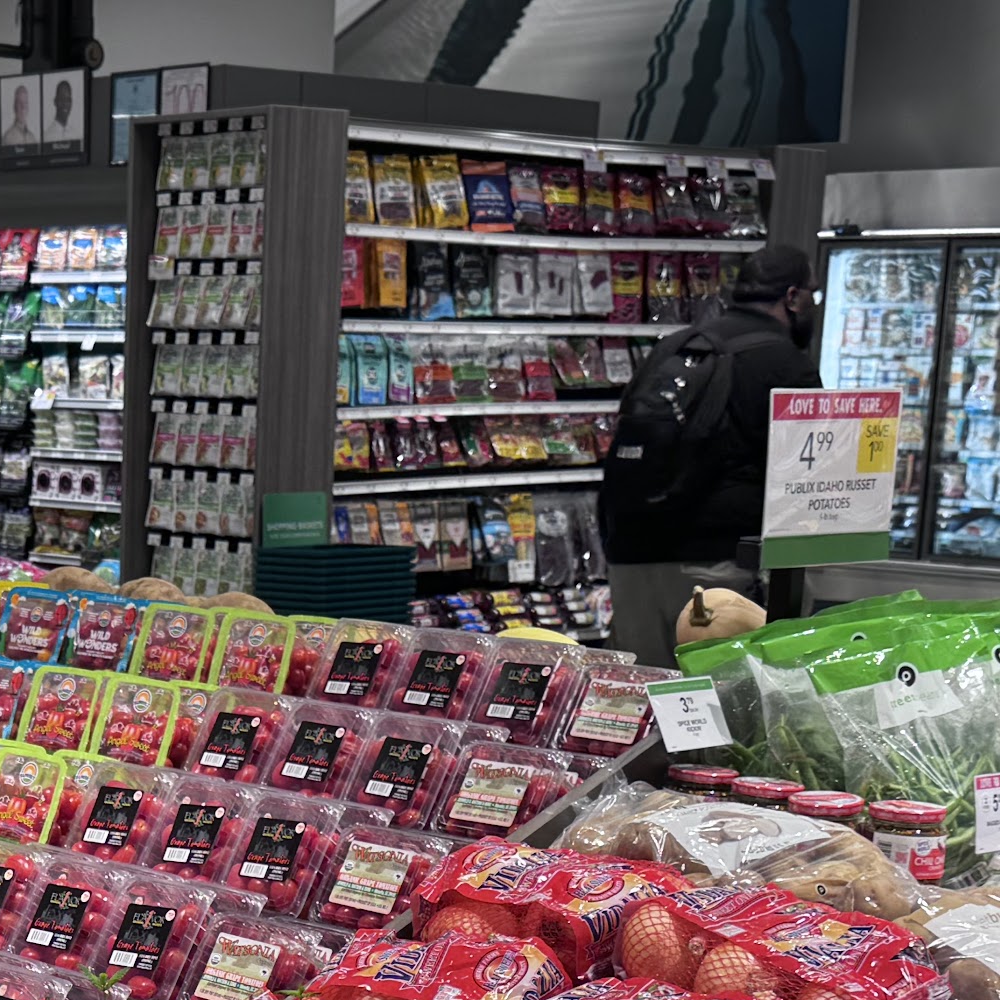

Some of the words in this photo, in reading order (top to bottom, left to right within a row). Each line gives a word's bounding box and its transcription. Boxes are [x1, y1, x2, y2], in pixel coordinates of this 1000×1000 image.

[790, 398, 814, 415] LOVE
[818, 398, 830, 414] TO
[834, 397, 856, 414] SAVE
[866, 424, 890, 439] SAVE
[785, 482, 816, 495] PUBLIX
[817, 480, 844, 493] IDAHO
[846, 478, 877, 491] RUSSET
[808, 498, 851, 511] POTATOES
[21, 624, 42, 636] WILD
[91, 629, 111, 642] WILD
[10, 633, 49, 649] WONDERS
[77, 639, 118, 652] WONDERS
